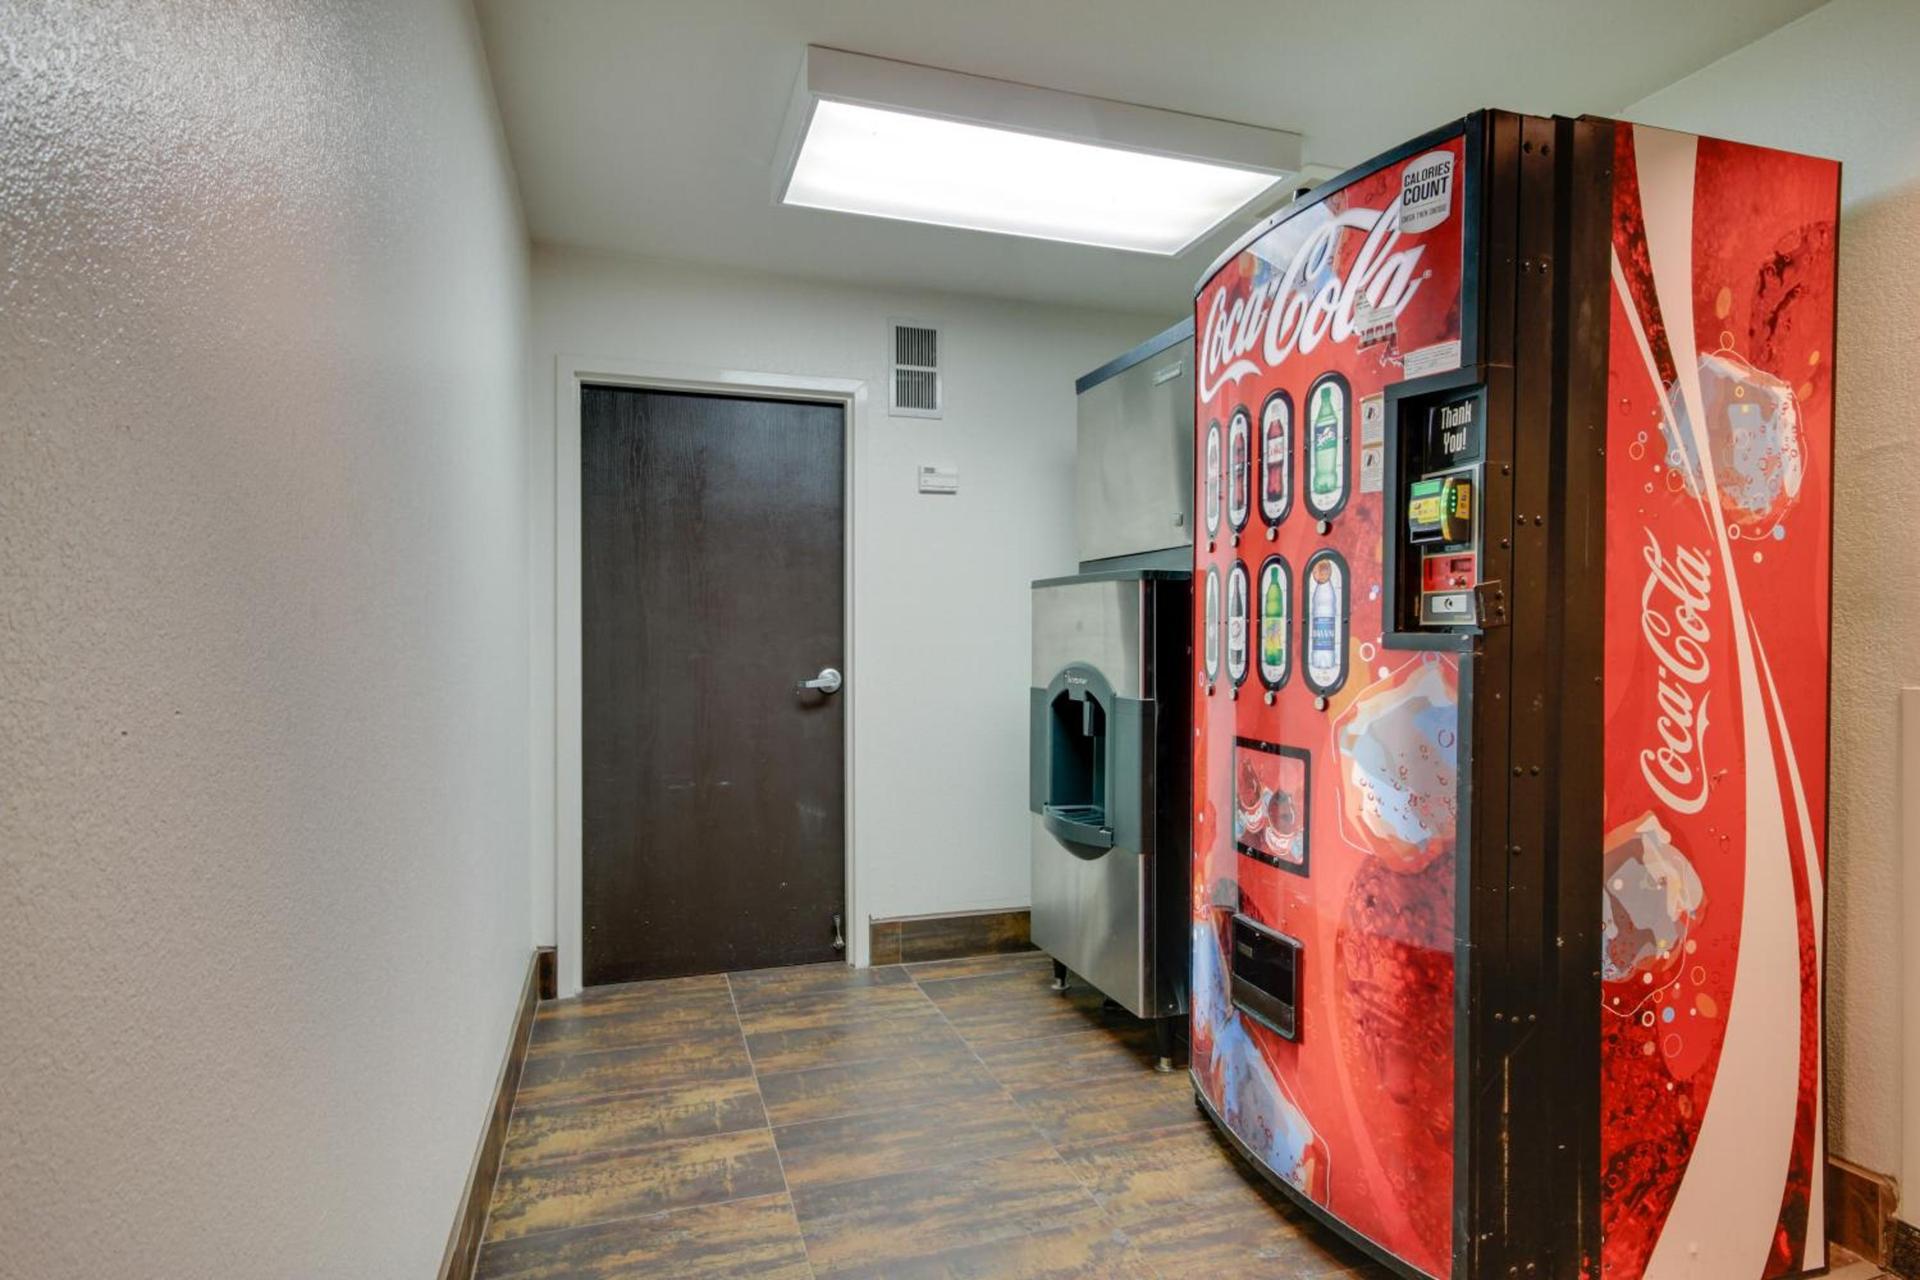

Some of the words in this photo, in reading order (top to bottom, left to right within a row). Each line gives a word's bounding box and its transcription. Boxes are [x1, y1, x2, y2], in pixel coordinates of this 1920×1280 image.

[1404, 161, 1451, 188] CALORIES
[1403, 176, 1449, 206] COUNT
[1441, 400, 1472, 430] Thank
[1443, 427, 1467, 455] You!
[1640, 526, 1711, 815] Coca-Cola
